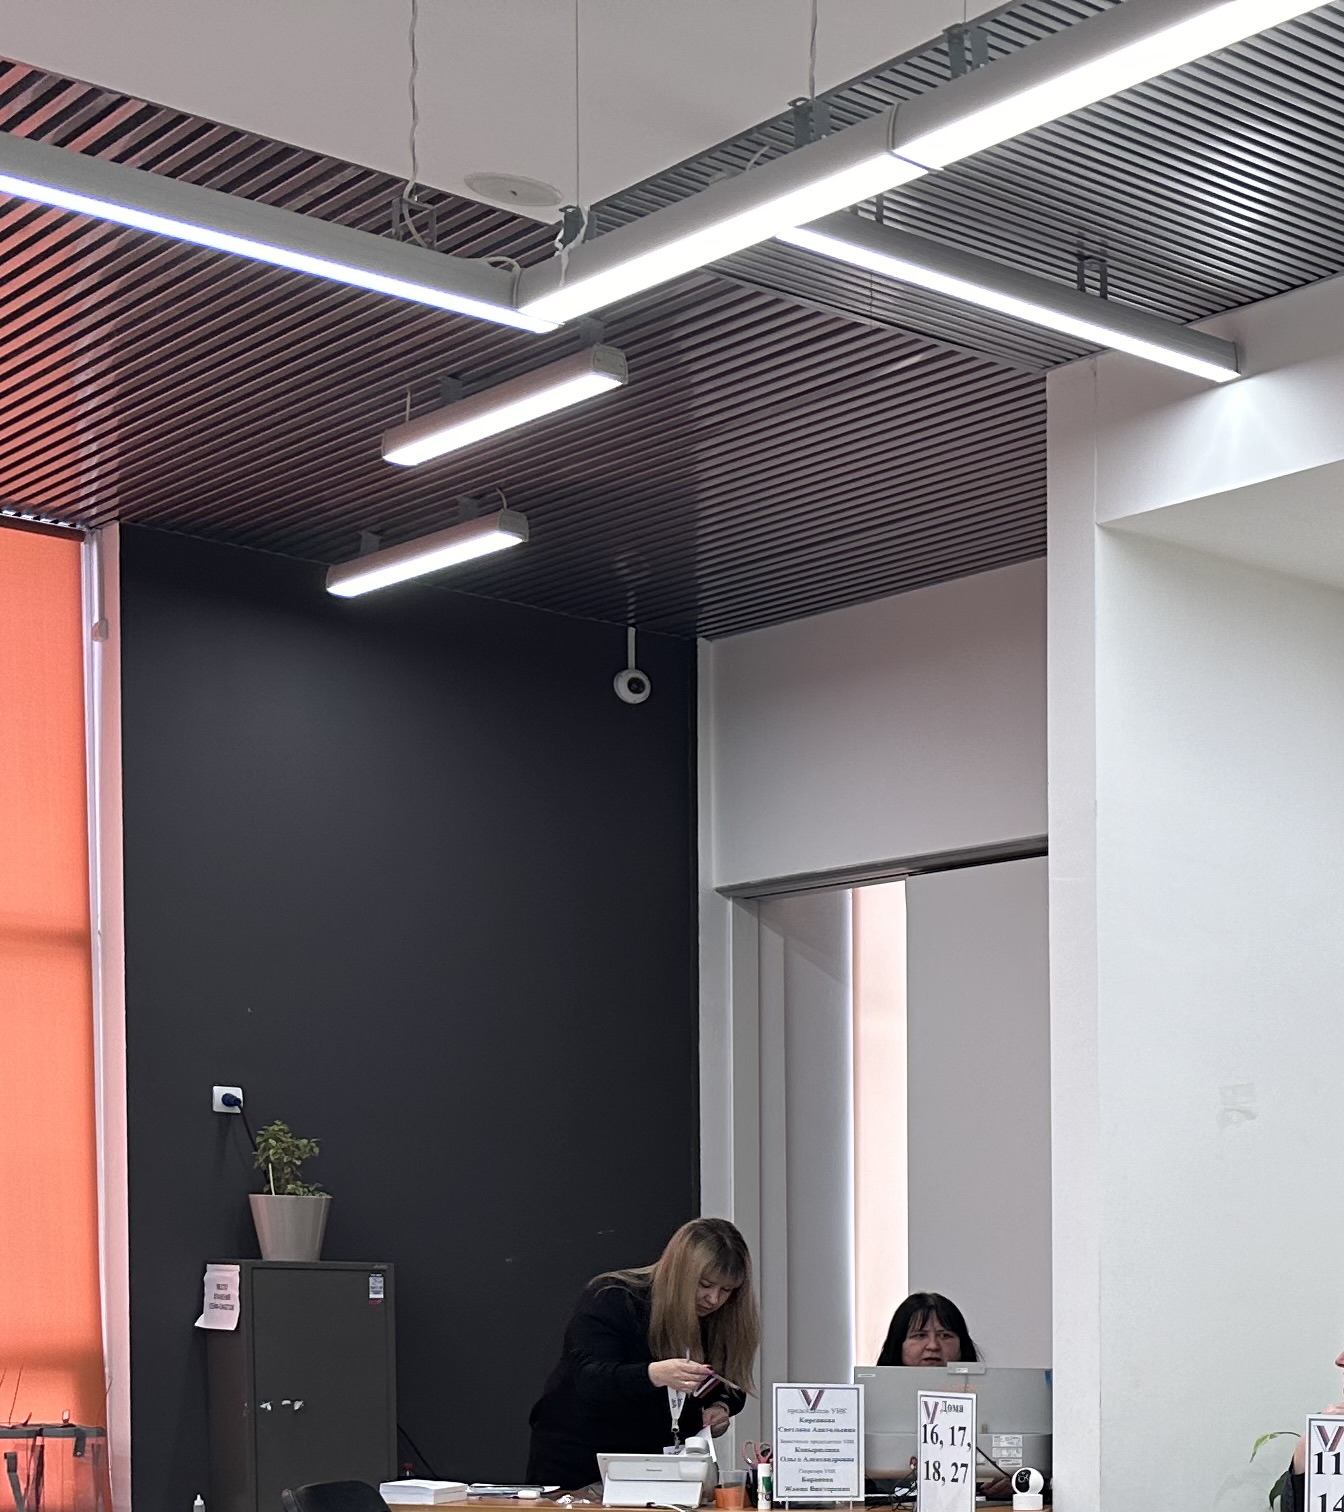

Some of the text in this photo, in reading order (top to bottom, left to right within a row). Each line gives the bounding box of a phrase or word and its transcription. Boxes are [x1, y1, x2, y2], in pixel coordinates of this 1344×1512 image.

[940, 1401, 964, 1414] Дома
[922, 1424, 972, 1452] 16, 17,
[924, 1460, 969, 1486] 18, 27
